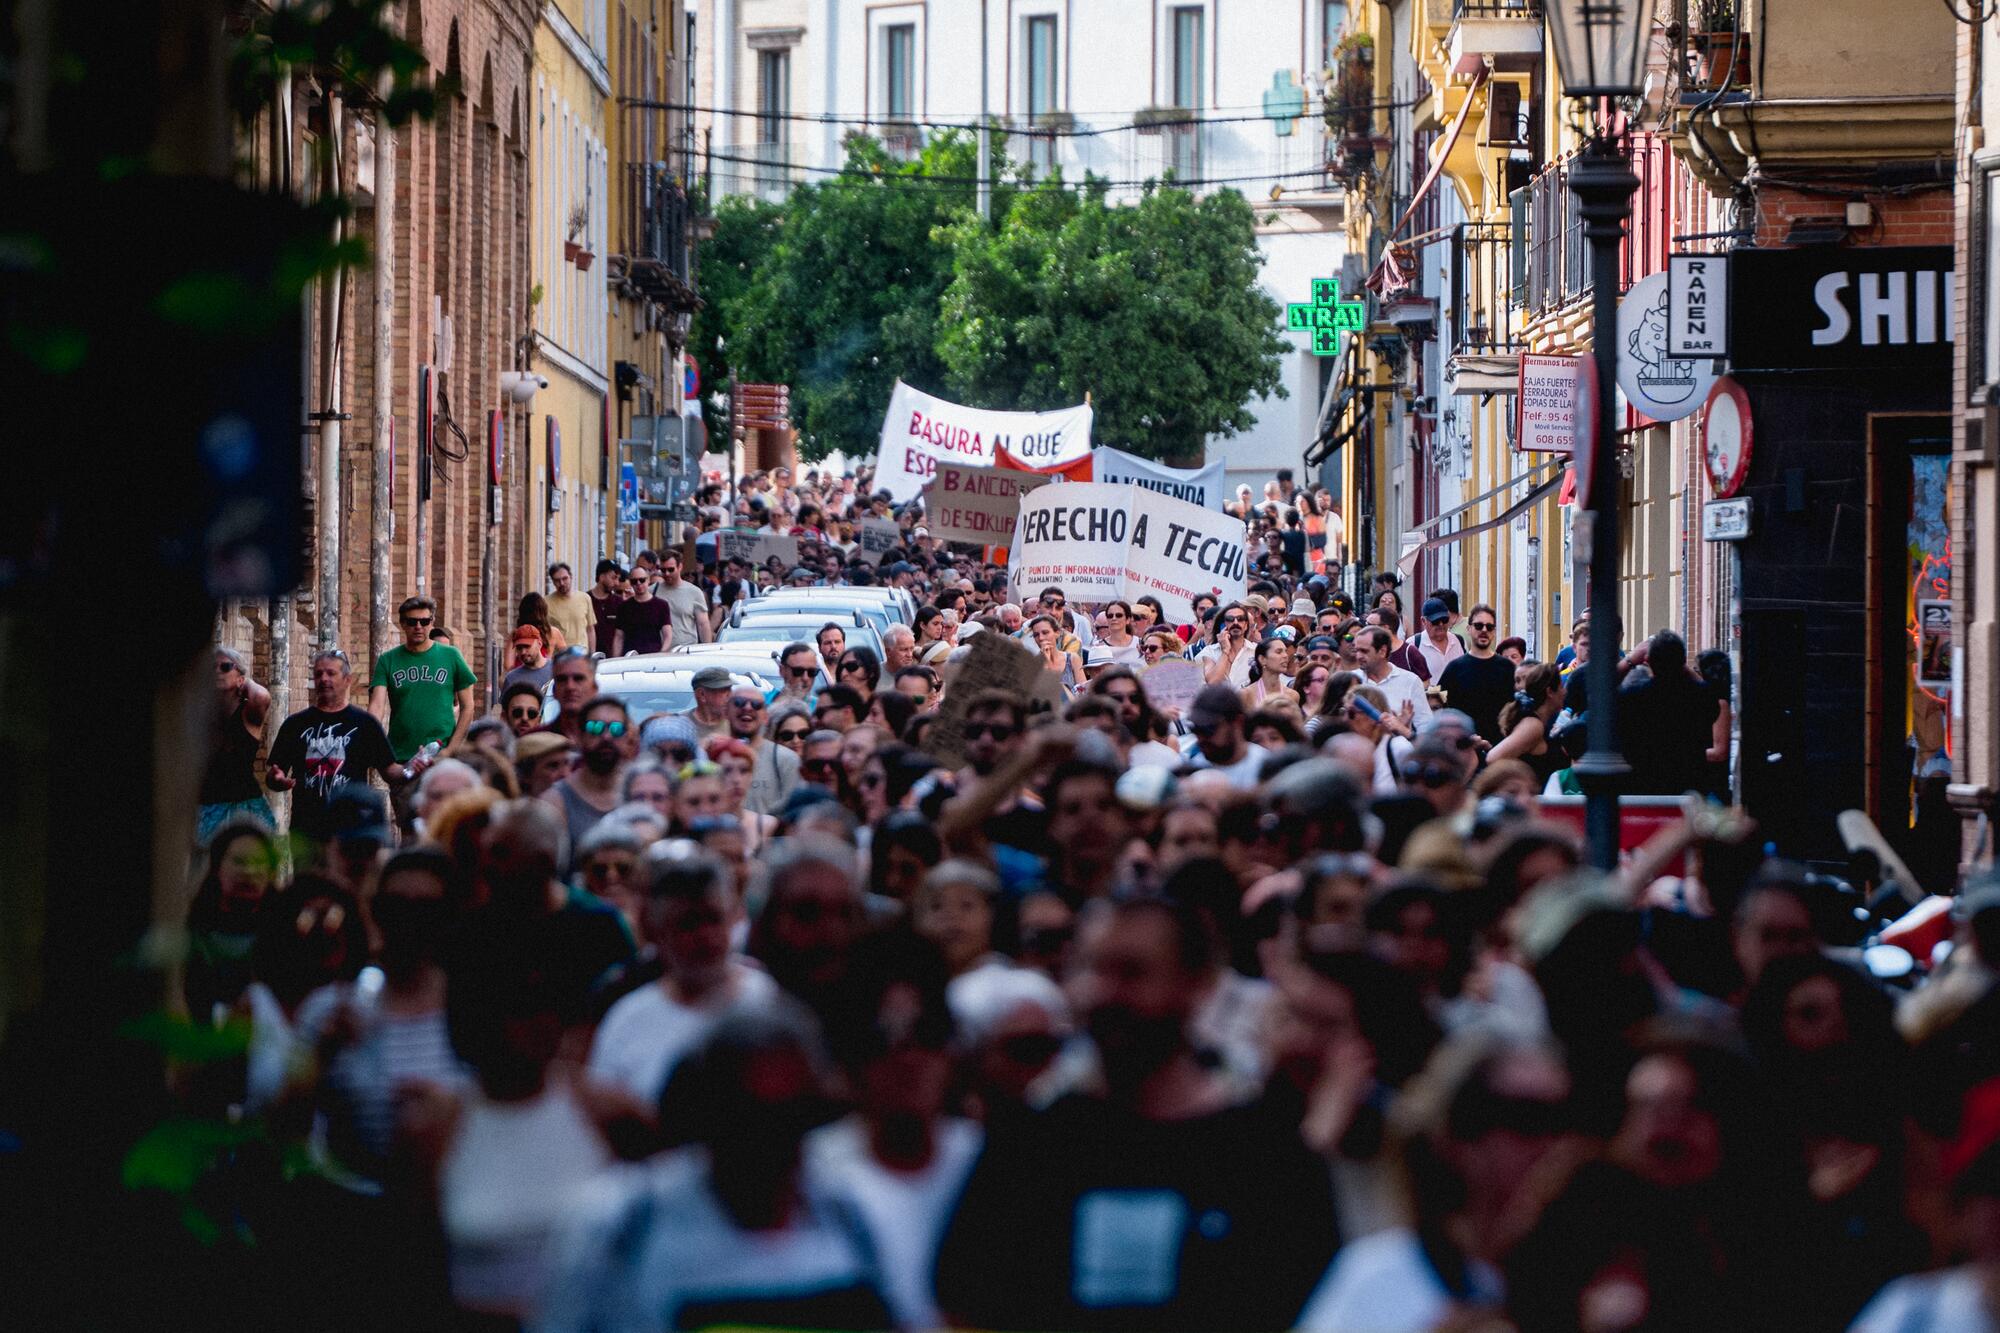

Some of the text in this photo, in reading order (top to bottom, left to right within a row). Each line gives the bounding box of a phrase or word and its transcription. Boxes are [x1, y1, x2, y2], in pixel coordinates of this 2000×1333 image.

[1687, 261, 1707, 335] RAMEN
[1682, 340, 1713, 350] BAR
[1524, 357, 1579, 368] Hermanos León
[1523, 377, 1577, 388] CAJAS FUERTES
[1523, 387, 1568, 398] CERRADURAS
[1523, 398, 1548, 408] COPIAS
[1549, 398, 1558, 408] DE
[909, 410, 983, 456] BASURA
[1022, 431, 1061, 457] QUE
[1536, 434, 1554, 444] 608
[944, 469, 1017, 496] BANCOS
[1131, 513, 1148, 549] A
[1028, 565, 1050, 575] PUNTO
[1052, 565, 1062, 575] DE
[1065, 564, 1116, 576] INFORMACIÓN
[1144, 575, 1149, 585] Y
[1028, 575, 1063, 584] DIAMANTINO
[392, 665, 448, 688] POLO
